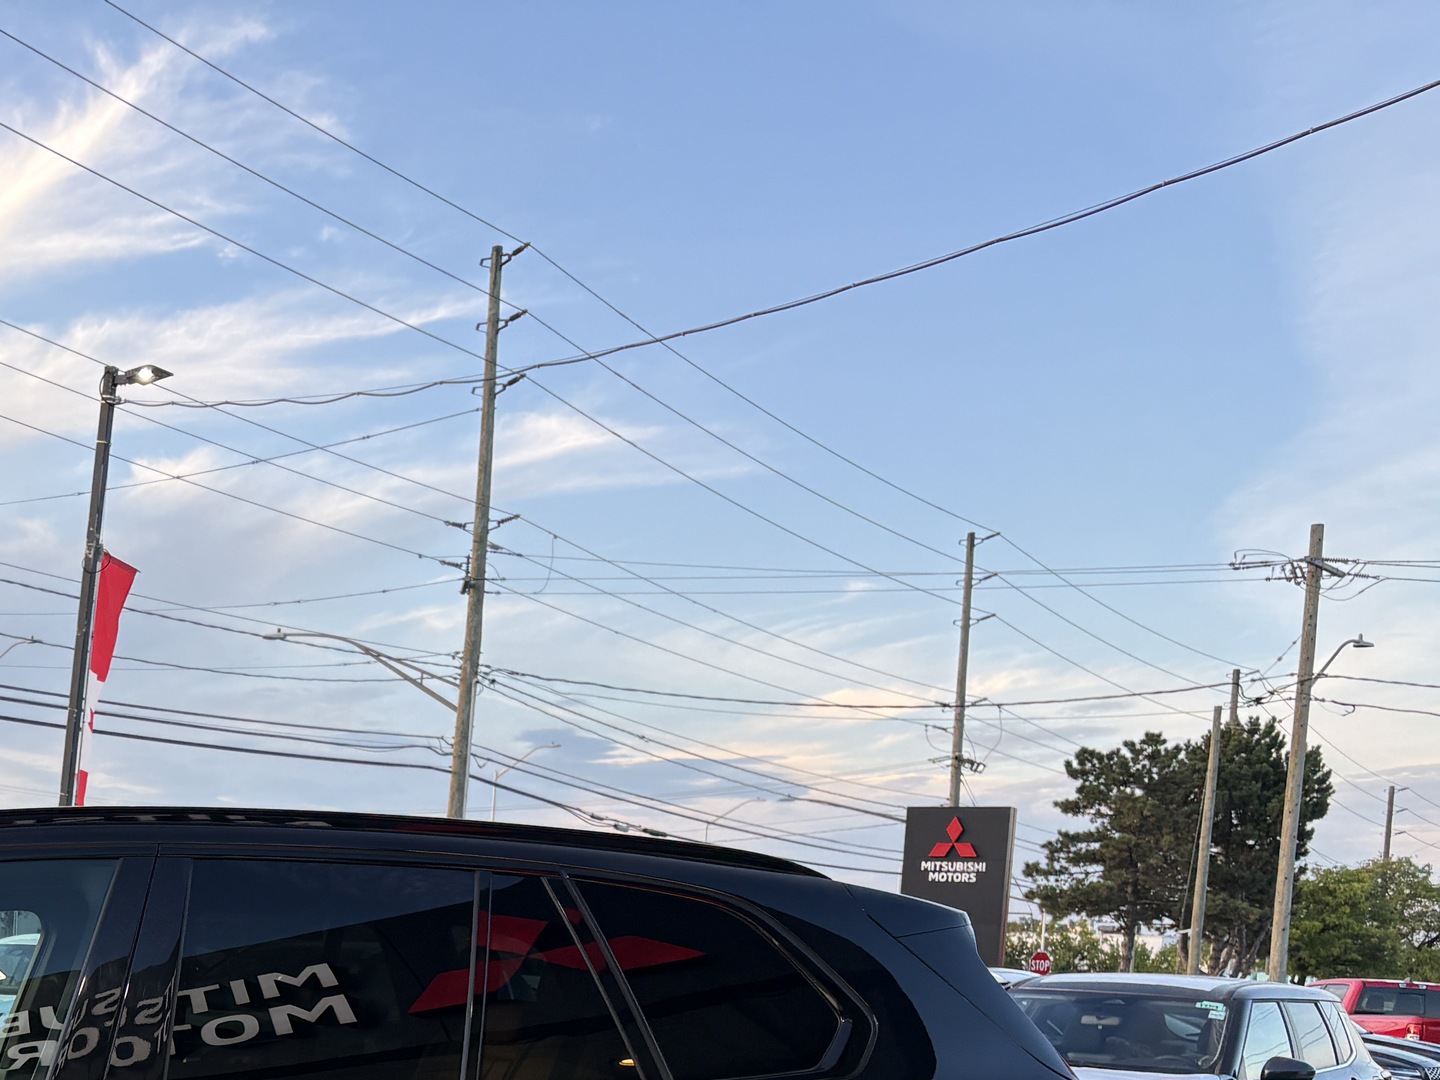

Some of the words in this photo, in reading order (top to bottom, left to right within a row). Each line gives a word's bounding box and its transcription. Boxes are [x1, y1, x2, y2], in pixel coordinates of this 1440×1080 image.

[920, 861, 987, 872] MITSUBISHI
[928, 872, 977, 883] MOTORS
[1031, 960, 1050, 971] STOP
